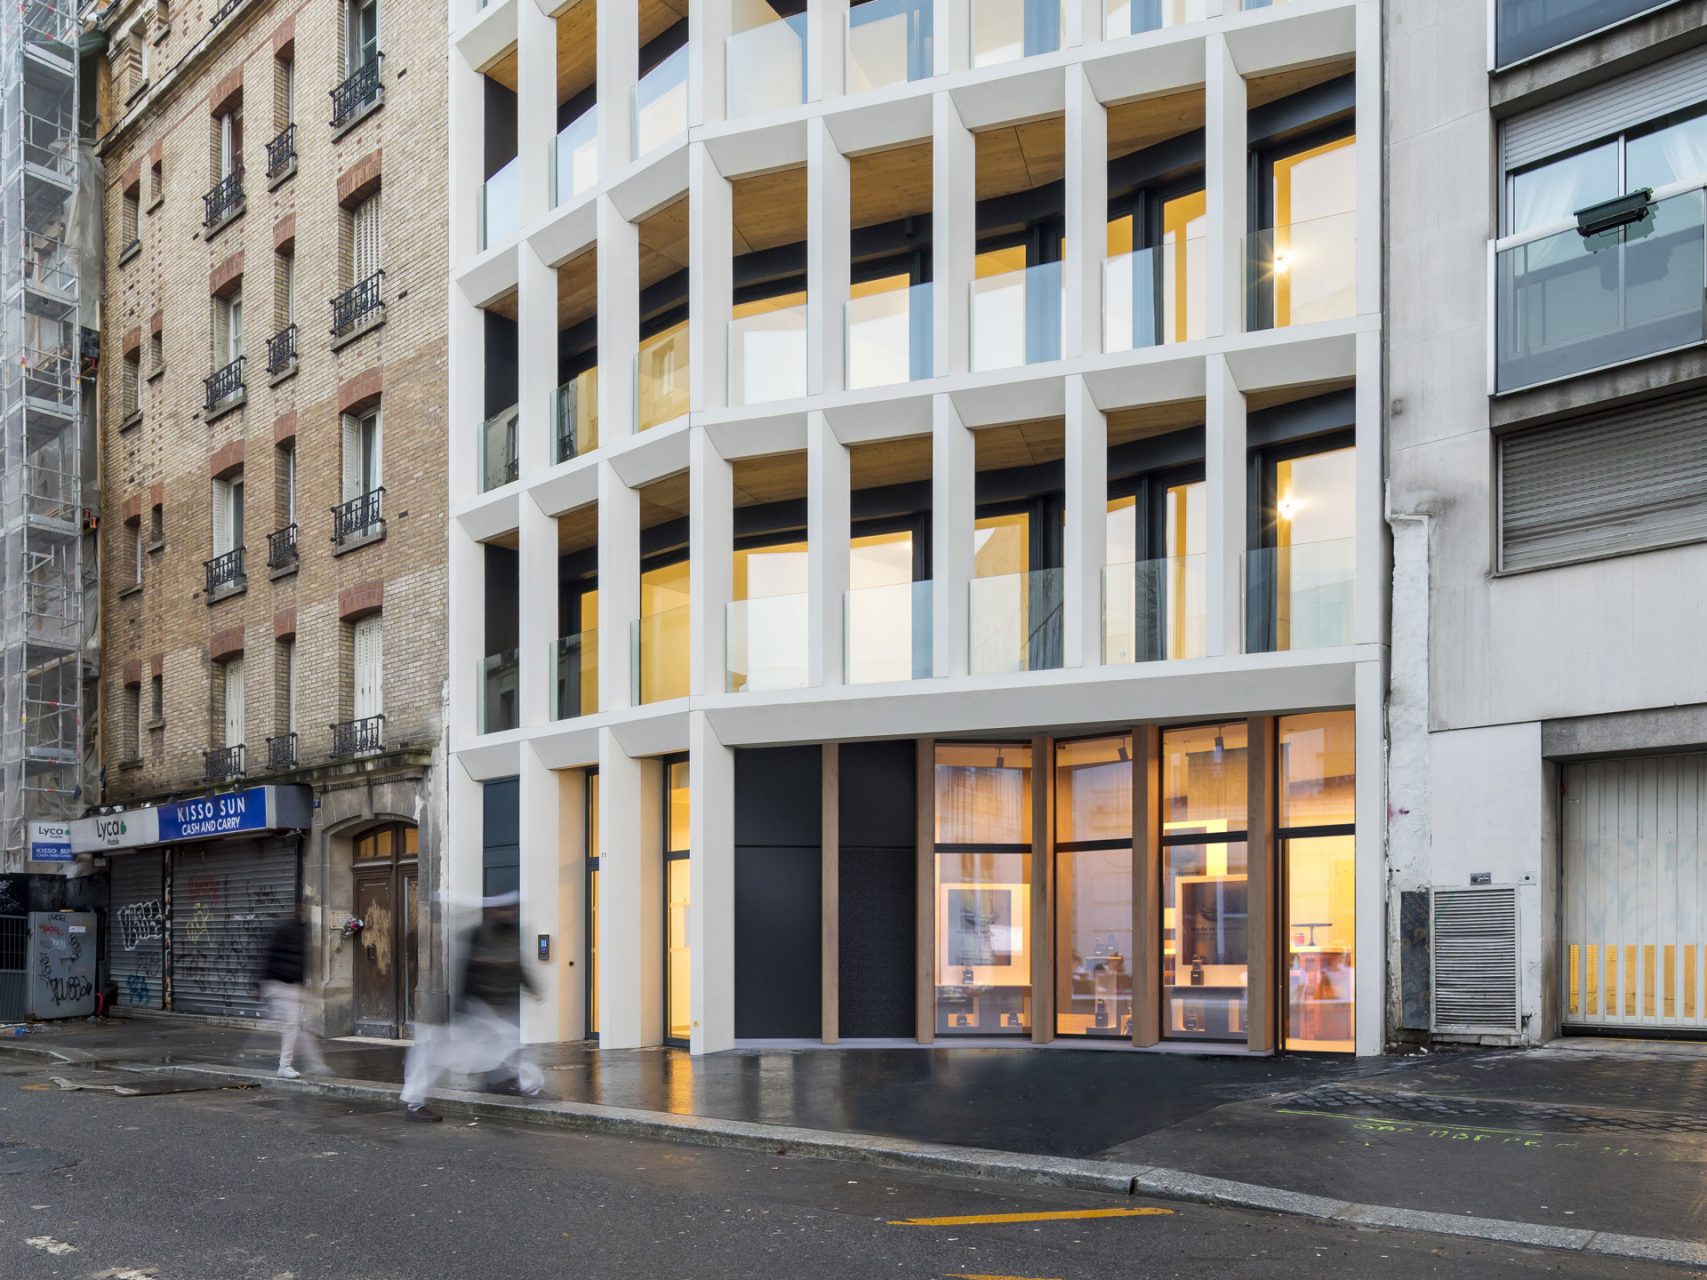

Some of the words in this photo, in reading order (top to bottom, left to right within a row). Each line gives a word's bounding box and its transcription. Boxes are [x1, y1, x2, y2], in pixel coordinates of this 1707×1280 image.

[177, 802, 213, 823] KISSO
[220, 797, 245, 816] SUN
[38, 826, 64, 836] Lyca
[96, 819, 119, 841] Lyca
[182, 822, 200, 836] CASH
[201, 820, 216, 833] AND
[217, 816, 241, 831] CARRY
